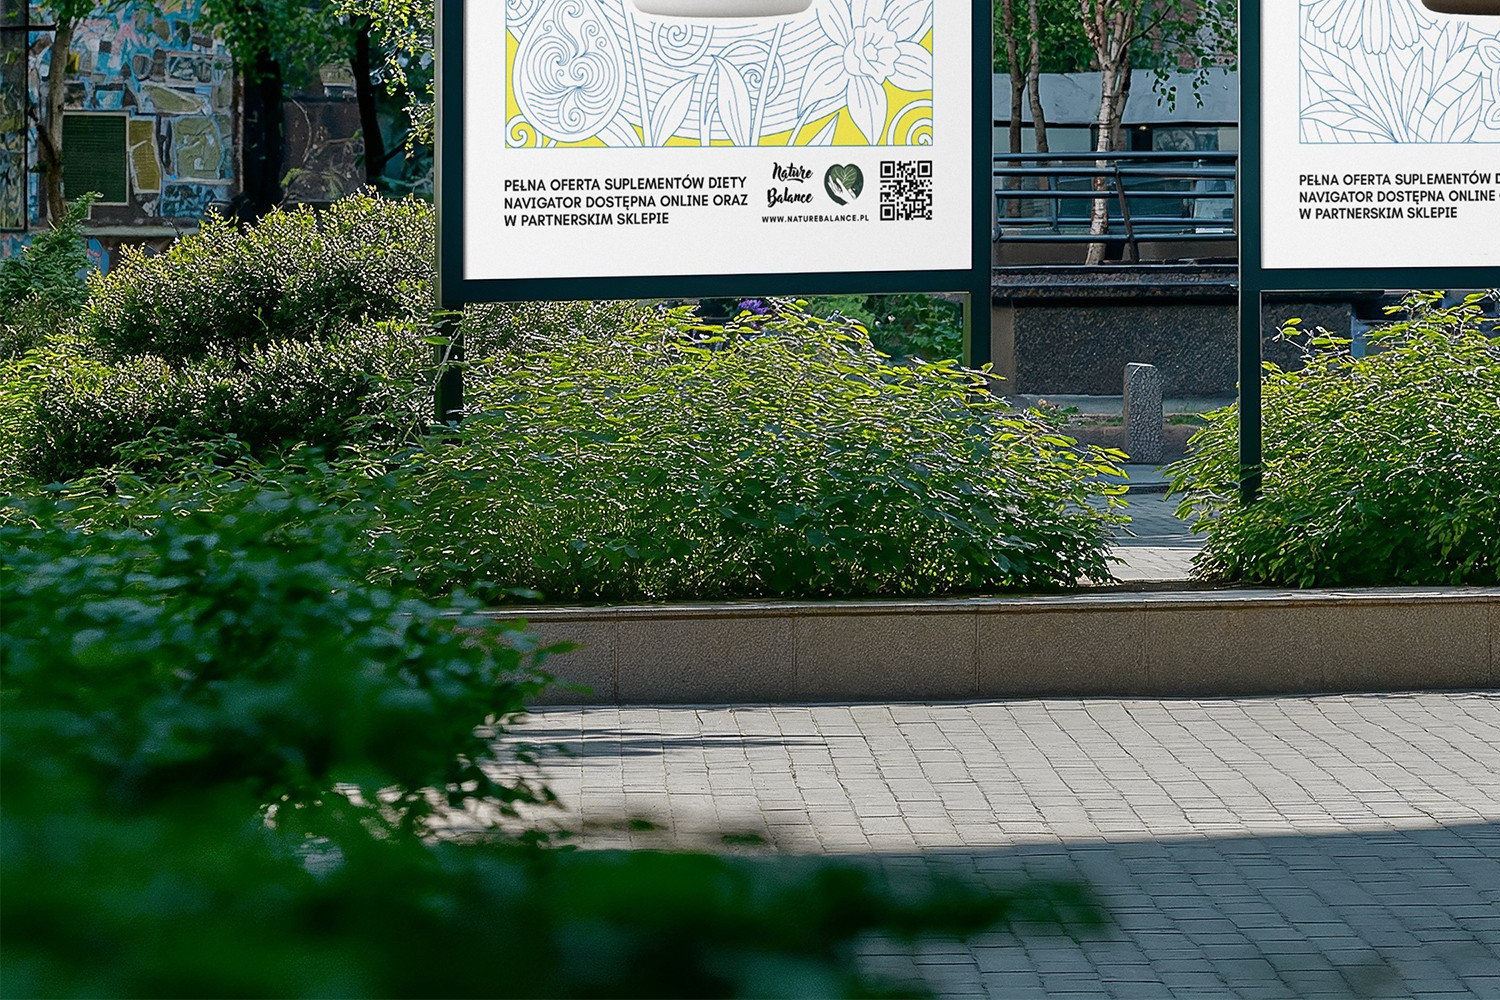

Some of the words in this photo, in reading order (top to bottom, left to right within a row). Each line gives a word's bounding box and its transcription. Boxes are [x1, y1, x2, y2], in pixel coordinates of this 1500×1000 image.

[772, 161, 813, 183] Nature
[1300, 175, 1339, 185] PEŁNA
[1343, 174, 1391, 185] OFERTA
[1395, 170, 1491, 185] SUPLEMENTÓW
[505, 179, 546, 191] PEŁNA
[550, 179, 600, 191] OFERTA
[605, 174, 704, 190] SUPLEMENTÓW
[709, 177, 746, 188] DIETY
[505, 197, 581, 209] NAVIGATOR
[586, 196, 656, 210] DOSTĘPNA
[660, 195, 708, 207] ONLINE
[713, 194, 748, 206] ORAZ
[767, 187, 813, 208] Balance
[1300, 191, 1373, 203] NAVIGATOR
[1378, 191, 1445, 205] DOSTĘPNA
[1449, 190, 1495, 201] ONLINE
[504, 215, 516, 226] W
[522, 214, 613, 226] PARTNERSKIM
[617, 213, 668, 225] SKLEPIE
[762, 214, 869, 223] WWW.NATUREBALANCE.PL
[1299, 208, 1311, 219] W
[1316, 207, 1403, 219] PARTNERSKIM
[1407, 207, 1457, 218] SKLEPIE
